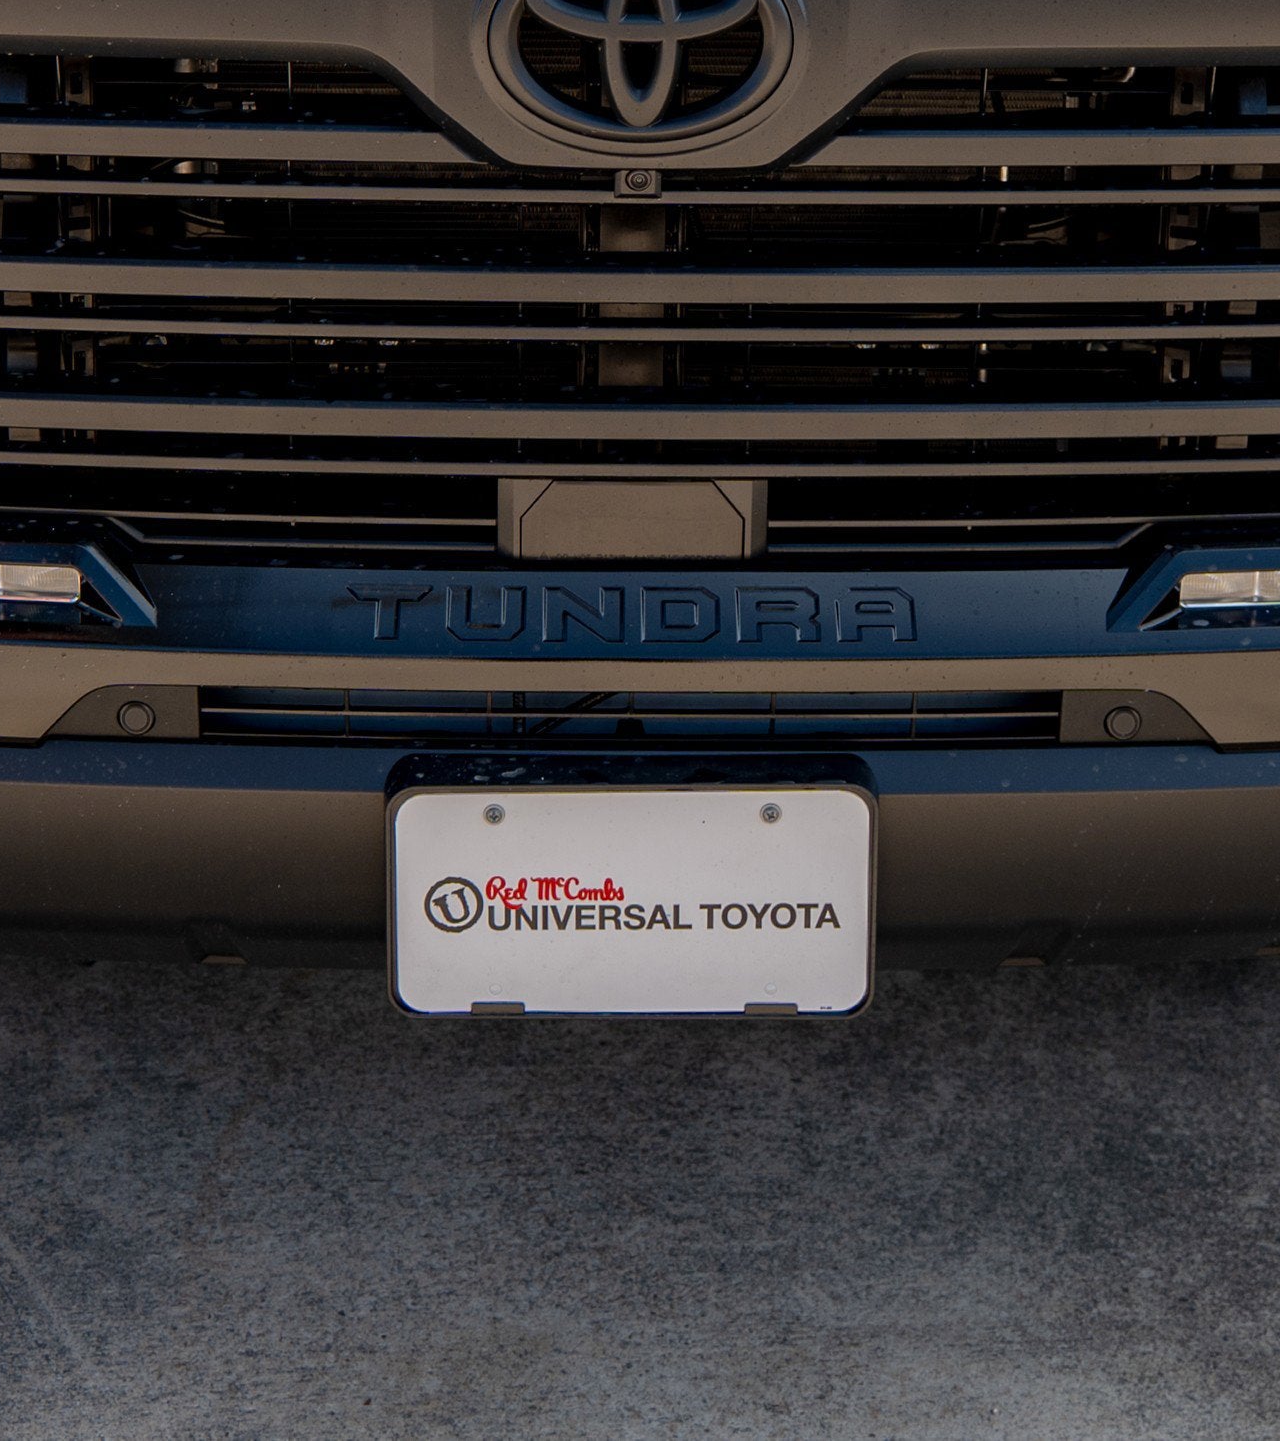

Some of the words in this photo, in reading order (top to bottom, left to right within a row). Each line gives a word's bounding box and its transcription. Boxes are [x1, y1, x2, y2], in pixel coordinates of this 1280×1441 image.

[346, 583, 918, 643] TUNDRA
[486, 876, 527, 909] Red
[531, 876, 625, 901] McCombs
[488, 904, 692, 931] UNIVERSAL
[699, 903, 841, 930] TOYOTA
